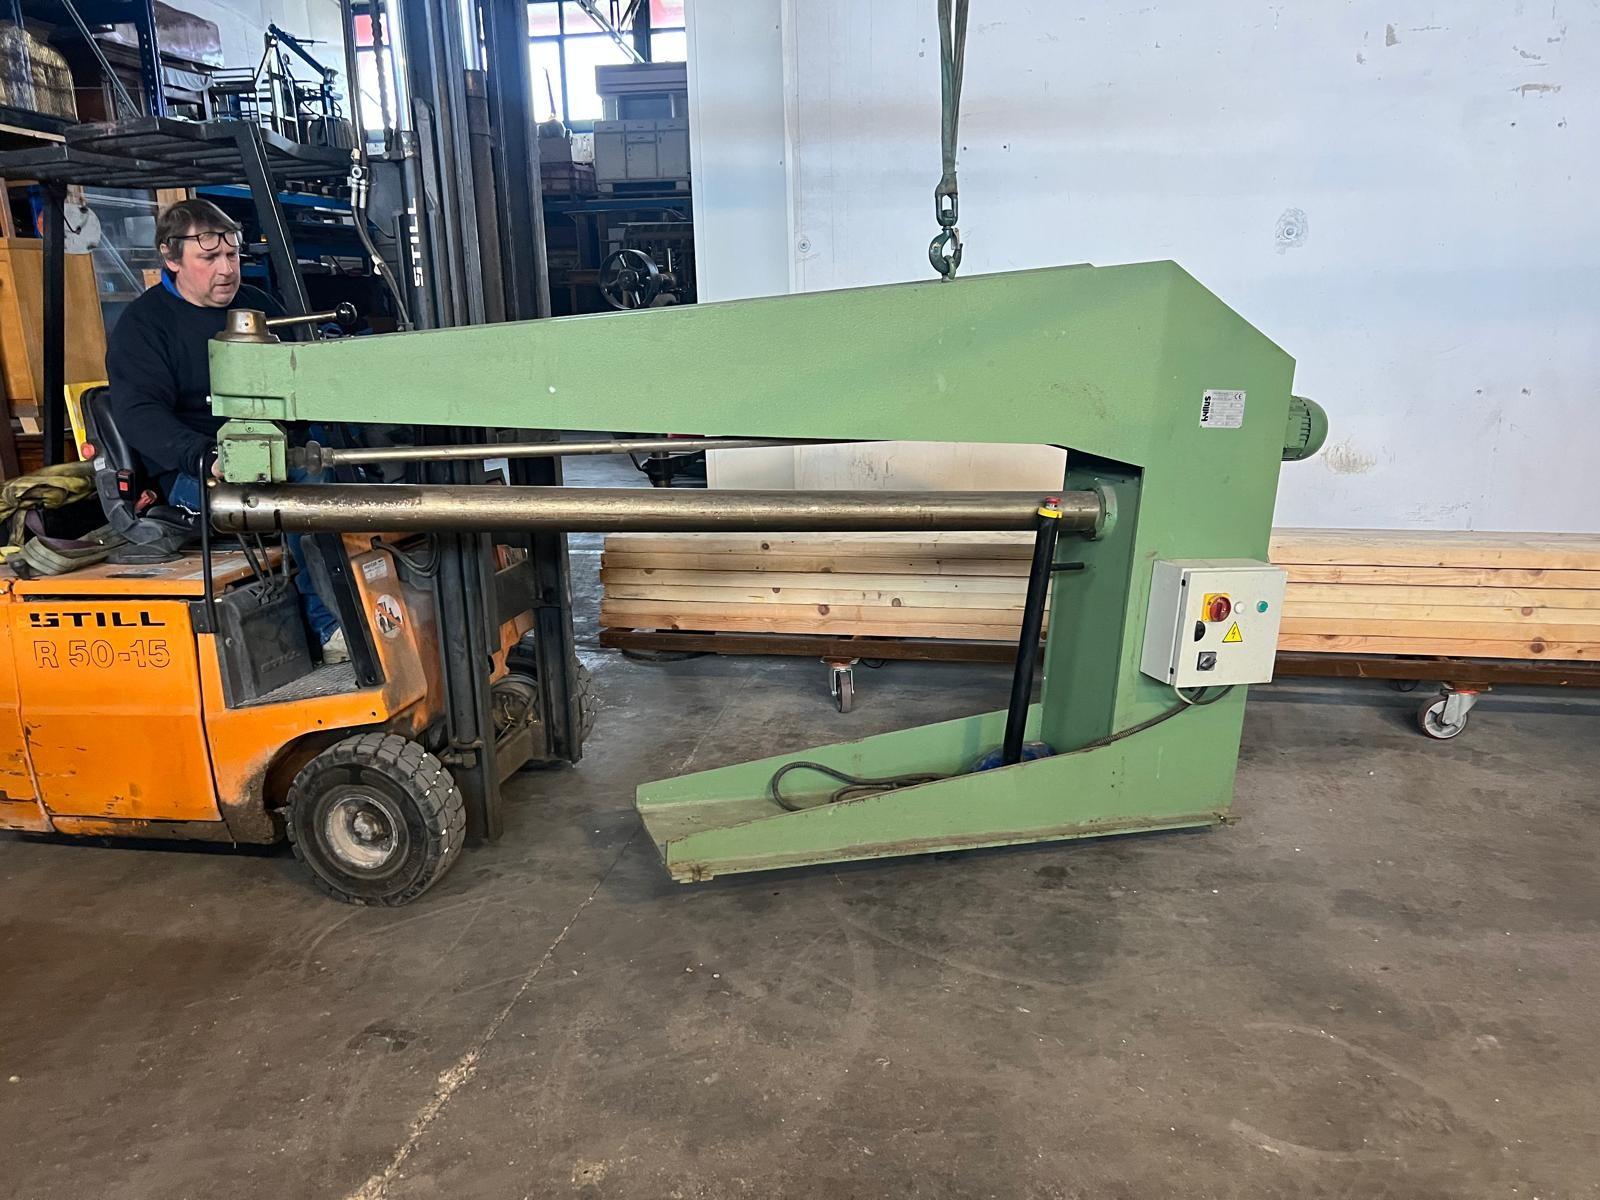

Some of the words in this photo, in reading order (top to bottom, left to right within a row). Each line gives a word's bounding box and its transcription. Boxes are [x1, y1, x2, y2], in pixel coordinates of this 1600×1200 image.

[407, 197, 424, 287] STILL
[29, 611, 166, 628] STILL
[33, 640, 60, 668] R
[68, 639, 171, 668] 50-15
